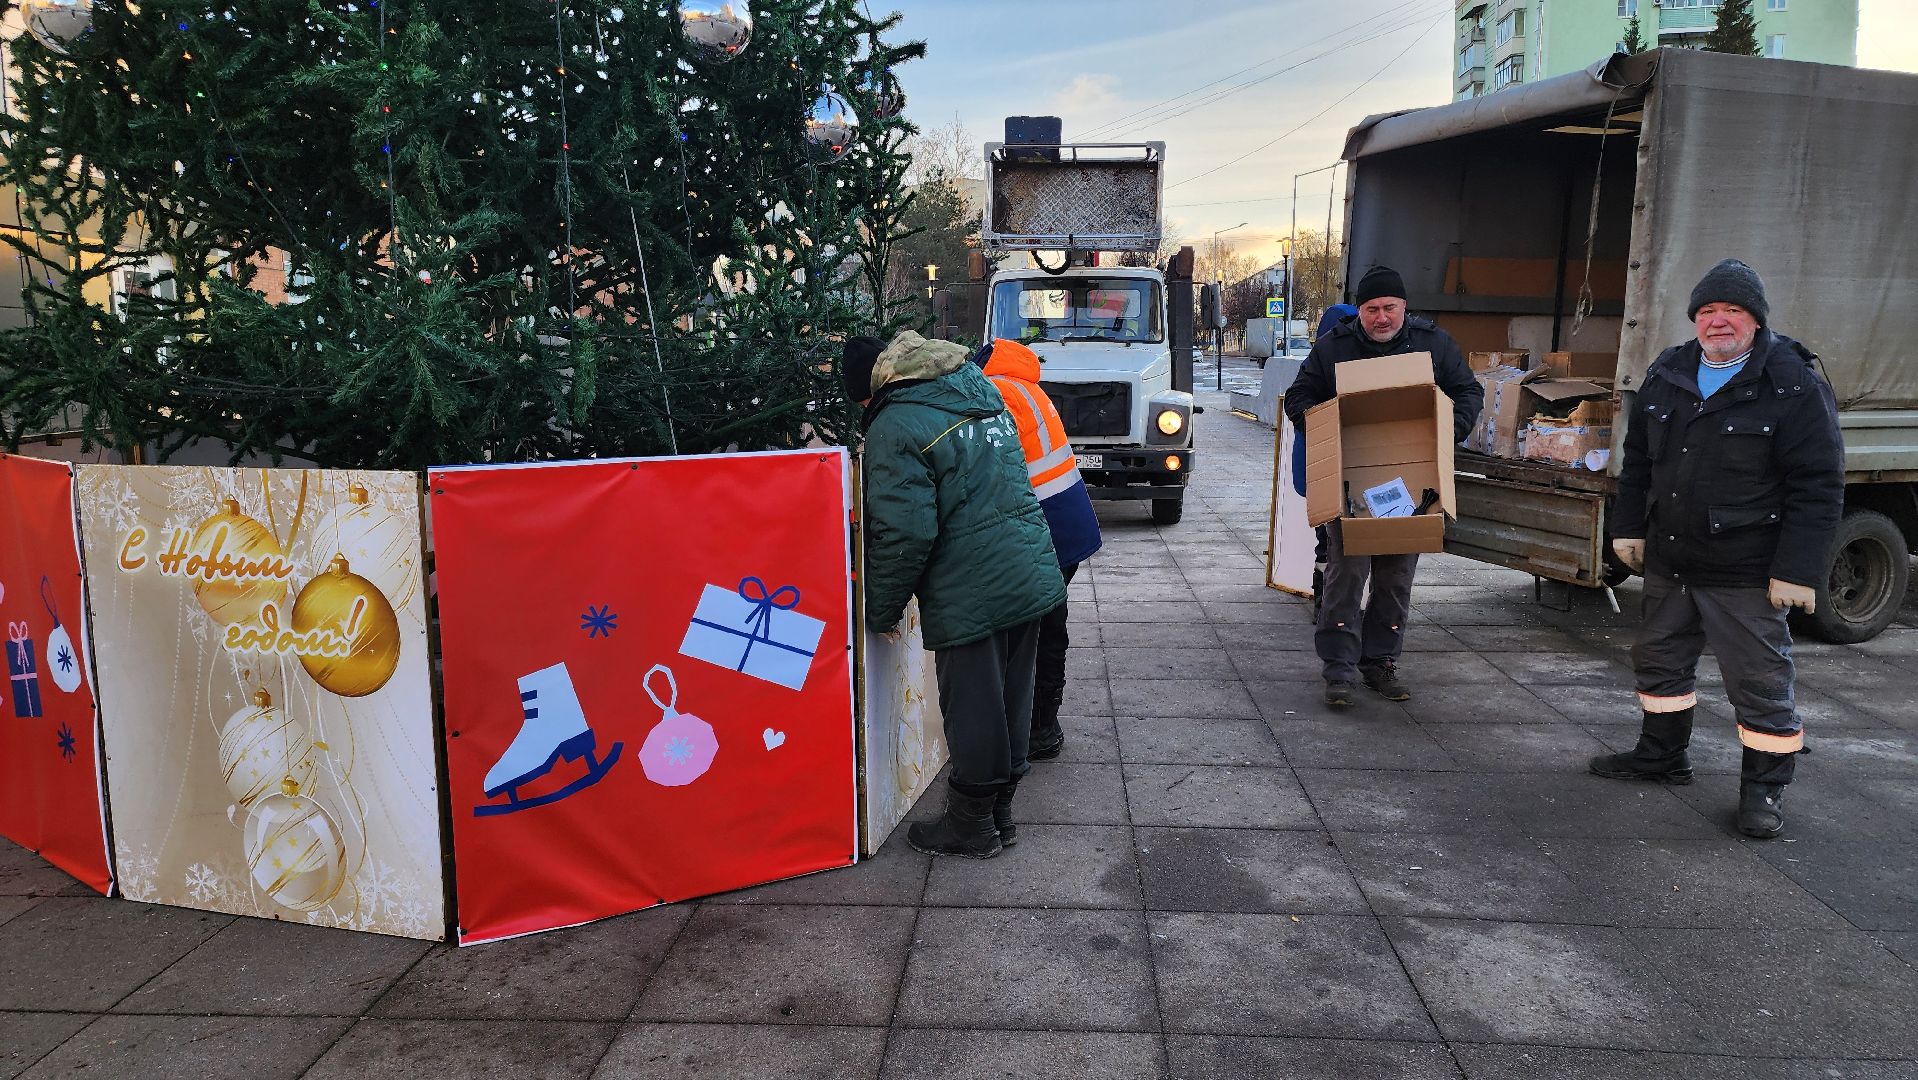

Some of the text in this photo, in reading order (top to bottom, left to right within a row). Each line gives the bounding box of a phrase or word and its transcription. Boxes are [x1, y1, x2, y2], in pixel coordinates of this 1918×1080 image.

[119, 523, 295, 581] С Новым
[224, 597, 367, 657] годом!
